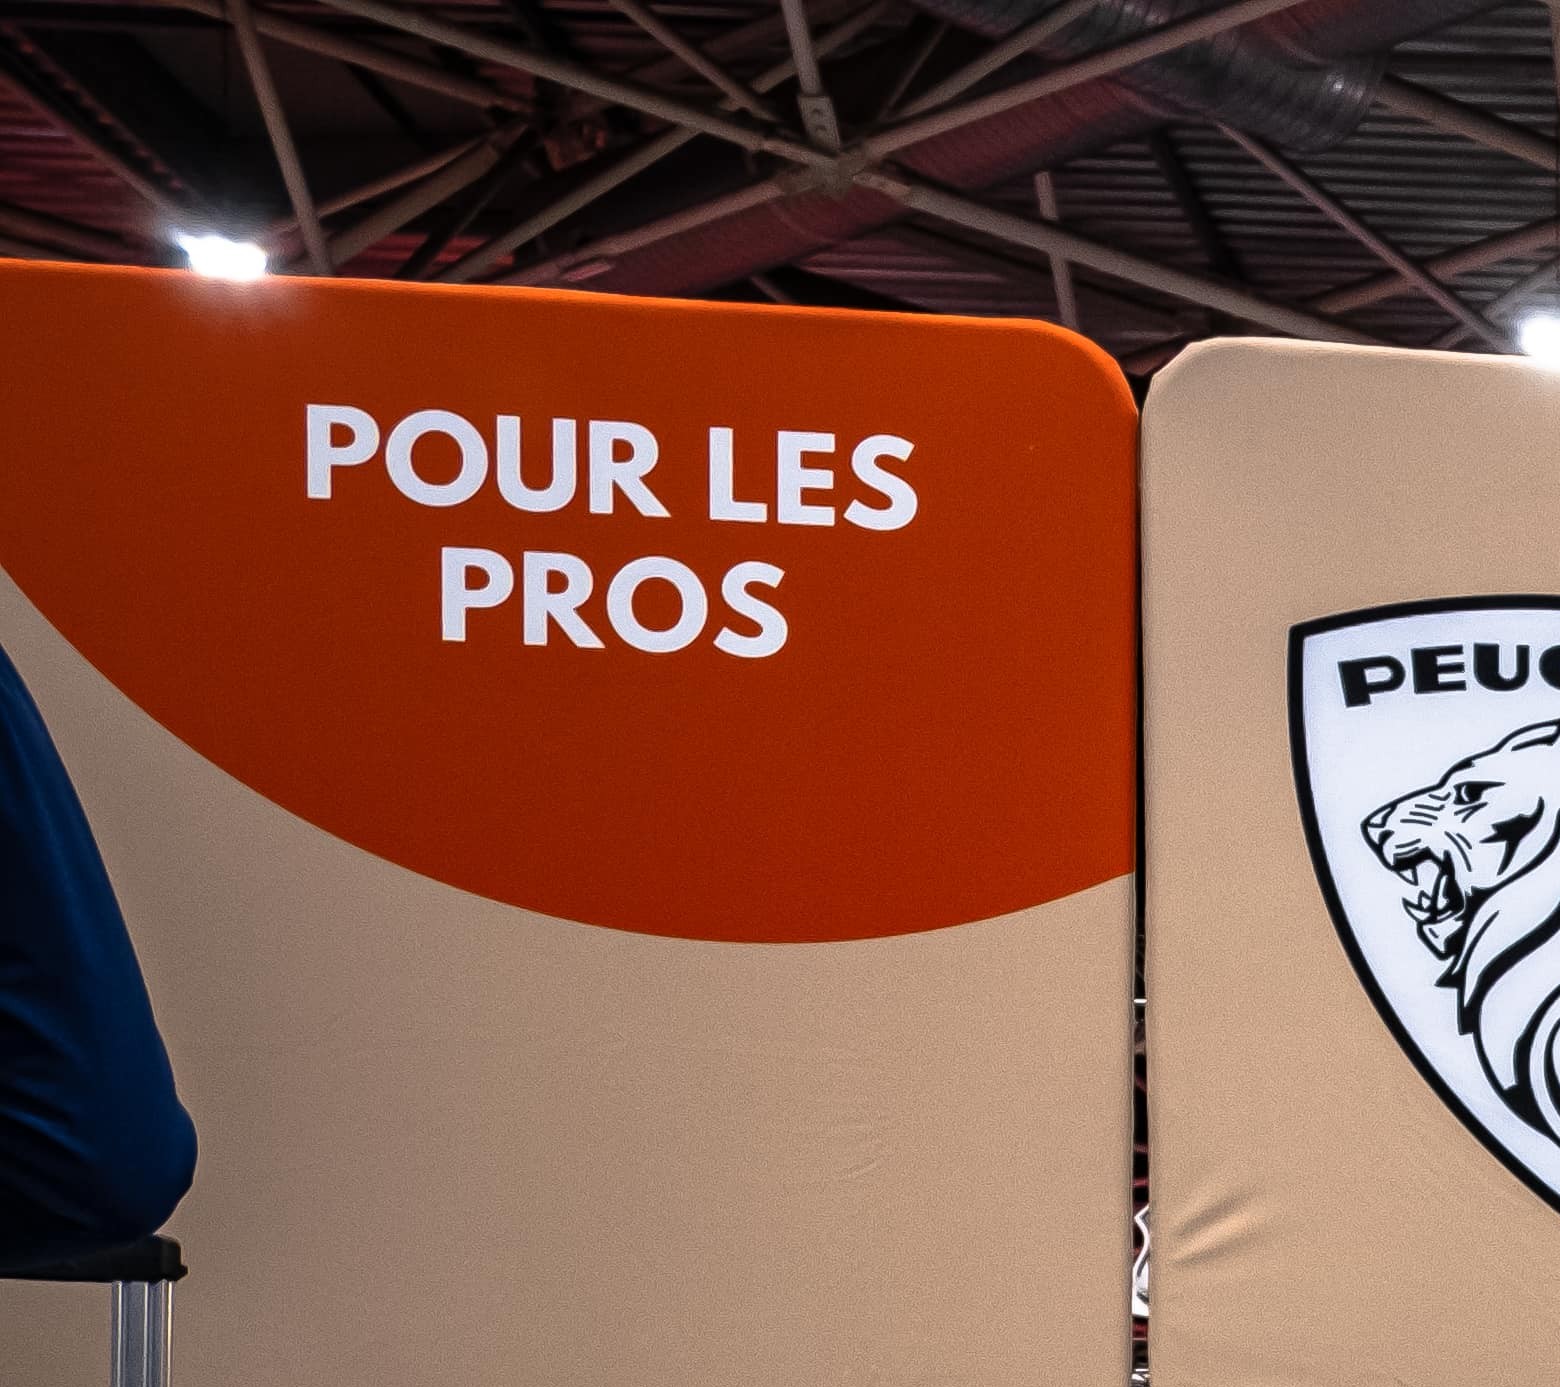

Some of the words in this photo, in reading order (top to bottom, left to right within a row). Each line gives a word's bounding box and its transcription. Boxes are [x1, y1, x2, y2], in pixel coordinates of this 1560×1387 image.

[305, 403, 671, 518] POUR
[708, 427, 918, 532] LES
[440, 546, 788, 658] PROS
